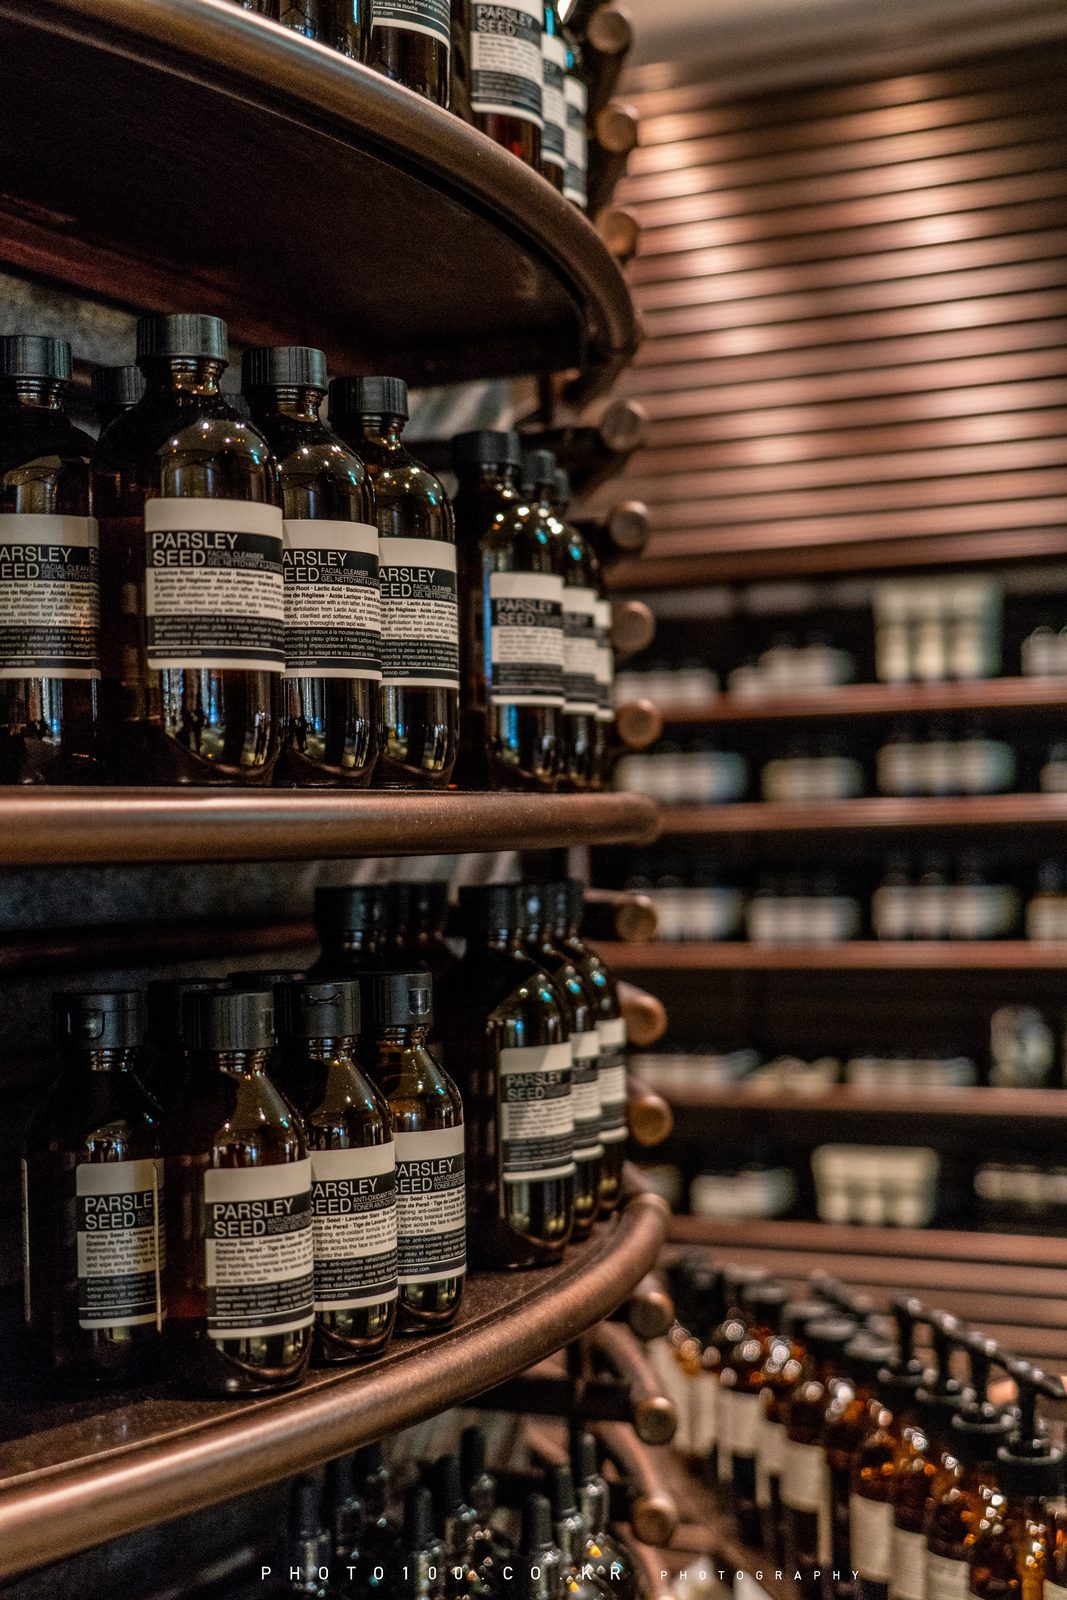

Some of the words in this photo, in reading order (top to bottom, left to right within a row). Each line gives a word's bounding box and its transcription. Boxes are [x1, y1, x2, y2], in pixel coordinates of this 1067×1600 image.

[477, 5, 534, 27] PARSLEY
[478, 19, 517, 36] SEED
[152, 532, 238, 549] PARSLEY
[0, 546, 72, 562] ARSLEY
[153, 550, 205, 566] SEED
[282, 551, 347, 566] ARSLEY
[2, 563, 39, 578] EED
[41, 563, 65, 571] FACIAL
[284, 568, 319, 582] EED
[379, 568, 435, 583] ARSLEY
[380, 584, 411, 597] EED
[497, 599, 553, 613] PARSLEY
[498, 613, 535, 625] SEED
[507, 1086, 545, 1101] SEED
[311, 1178, 377, 1198] ARSLEY
[85, 1193, 152, 1213] PARSLE
[213, 1198, 293, 1220] PARSLEY
[353, 1203, 373, 1212] TONER
[86, 1212, 135, 1229] SEED
[214, 1220, 266, 1237] SEED
